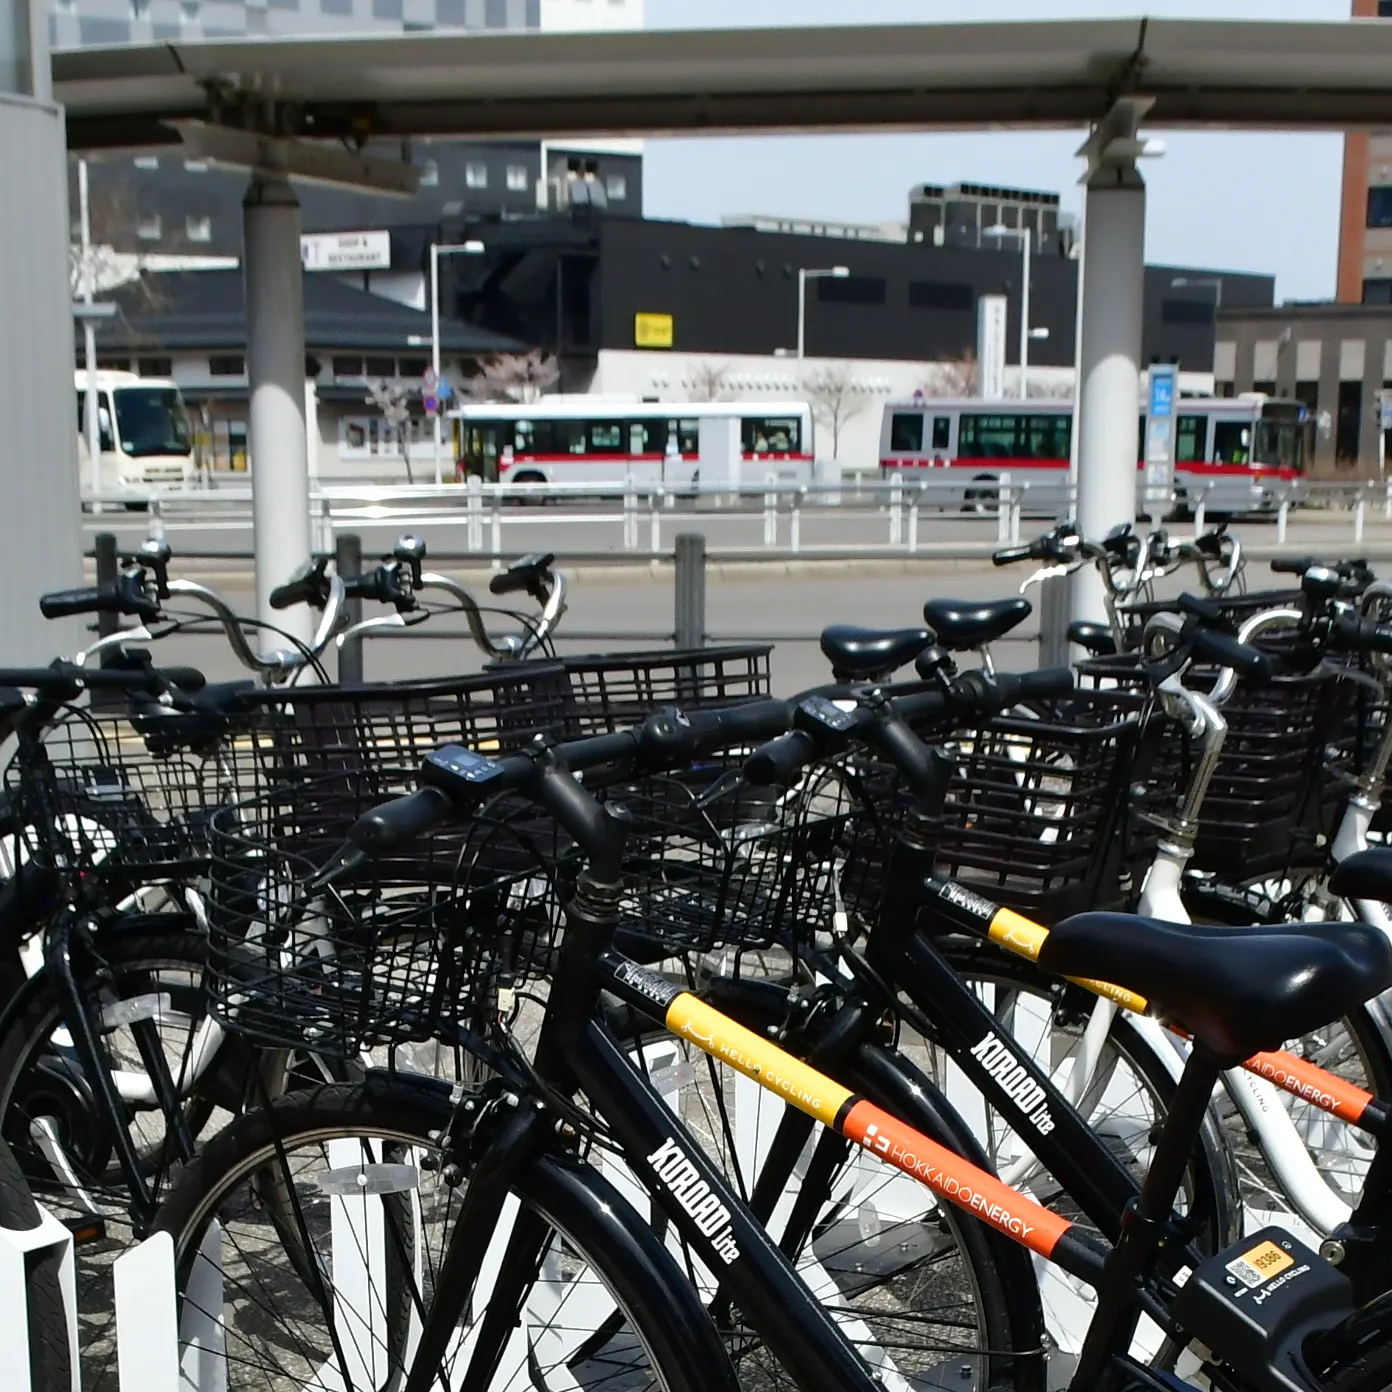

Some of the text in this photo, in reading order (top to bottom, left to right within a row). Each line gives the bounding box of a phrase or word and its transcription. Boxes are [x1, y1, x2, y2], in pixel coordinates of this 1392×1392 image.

[719, 1044, 822, 1110] HELLO CYCLING
[891, 1143, 1034, 1239] HOKKAIDOENERGY
